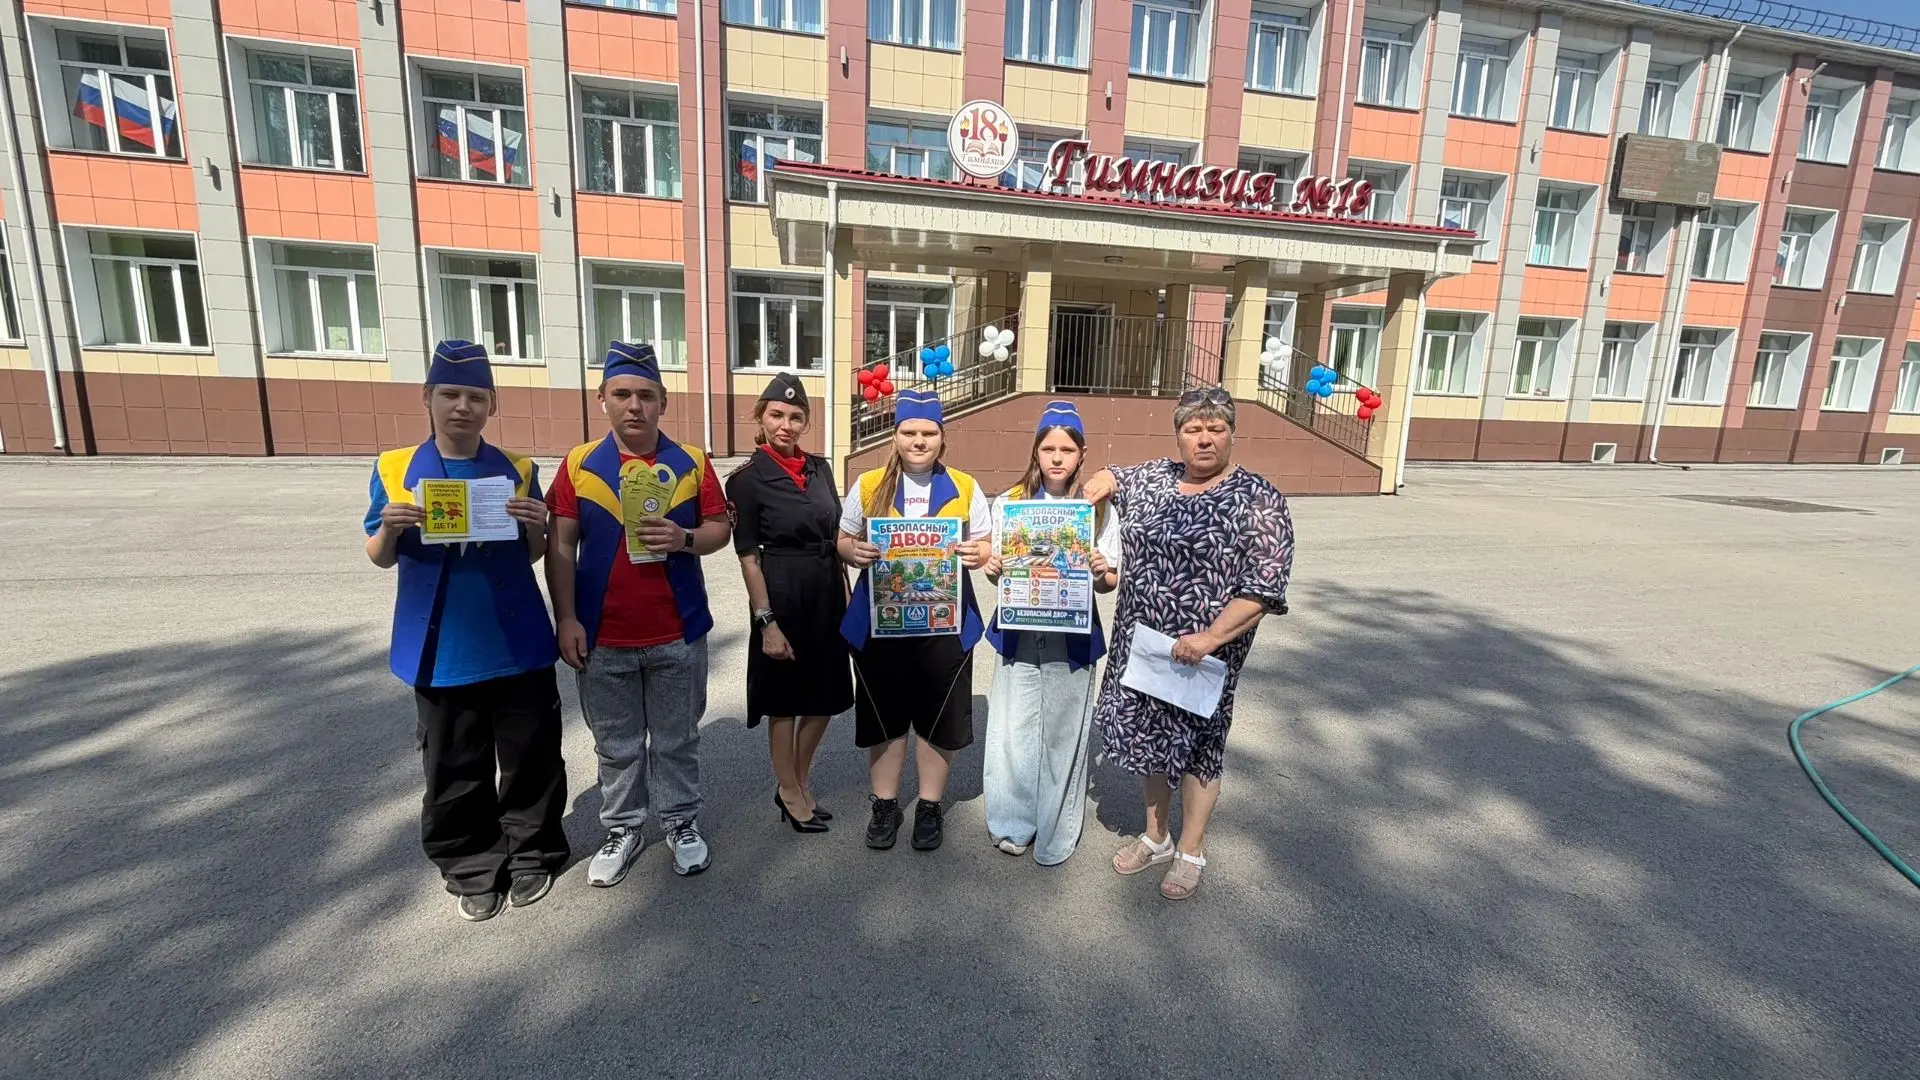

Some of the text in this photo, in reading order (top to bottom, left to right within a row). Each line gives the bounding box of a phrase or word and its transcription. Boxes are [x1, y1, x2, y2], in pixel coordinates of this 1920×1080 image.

[968, 108, 998, 141] 18
[1048, 140, 1277, 207] Гимназия
[1021, 507, 1076, 517] БЕЗОПАСНЫЙ
[1032, 516, 1065, 526] ДВОР
[880, 522, 948, 534] БЕЗОПАСНЫЙ
[890, 533, 942, 548] ДВОР
[1016, 609, 1052, 618] БЕЗОПАСНЫЙ
[1052, 611, 1068, 619] ДВОР
